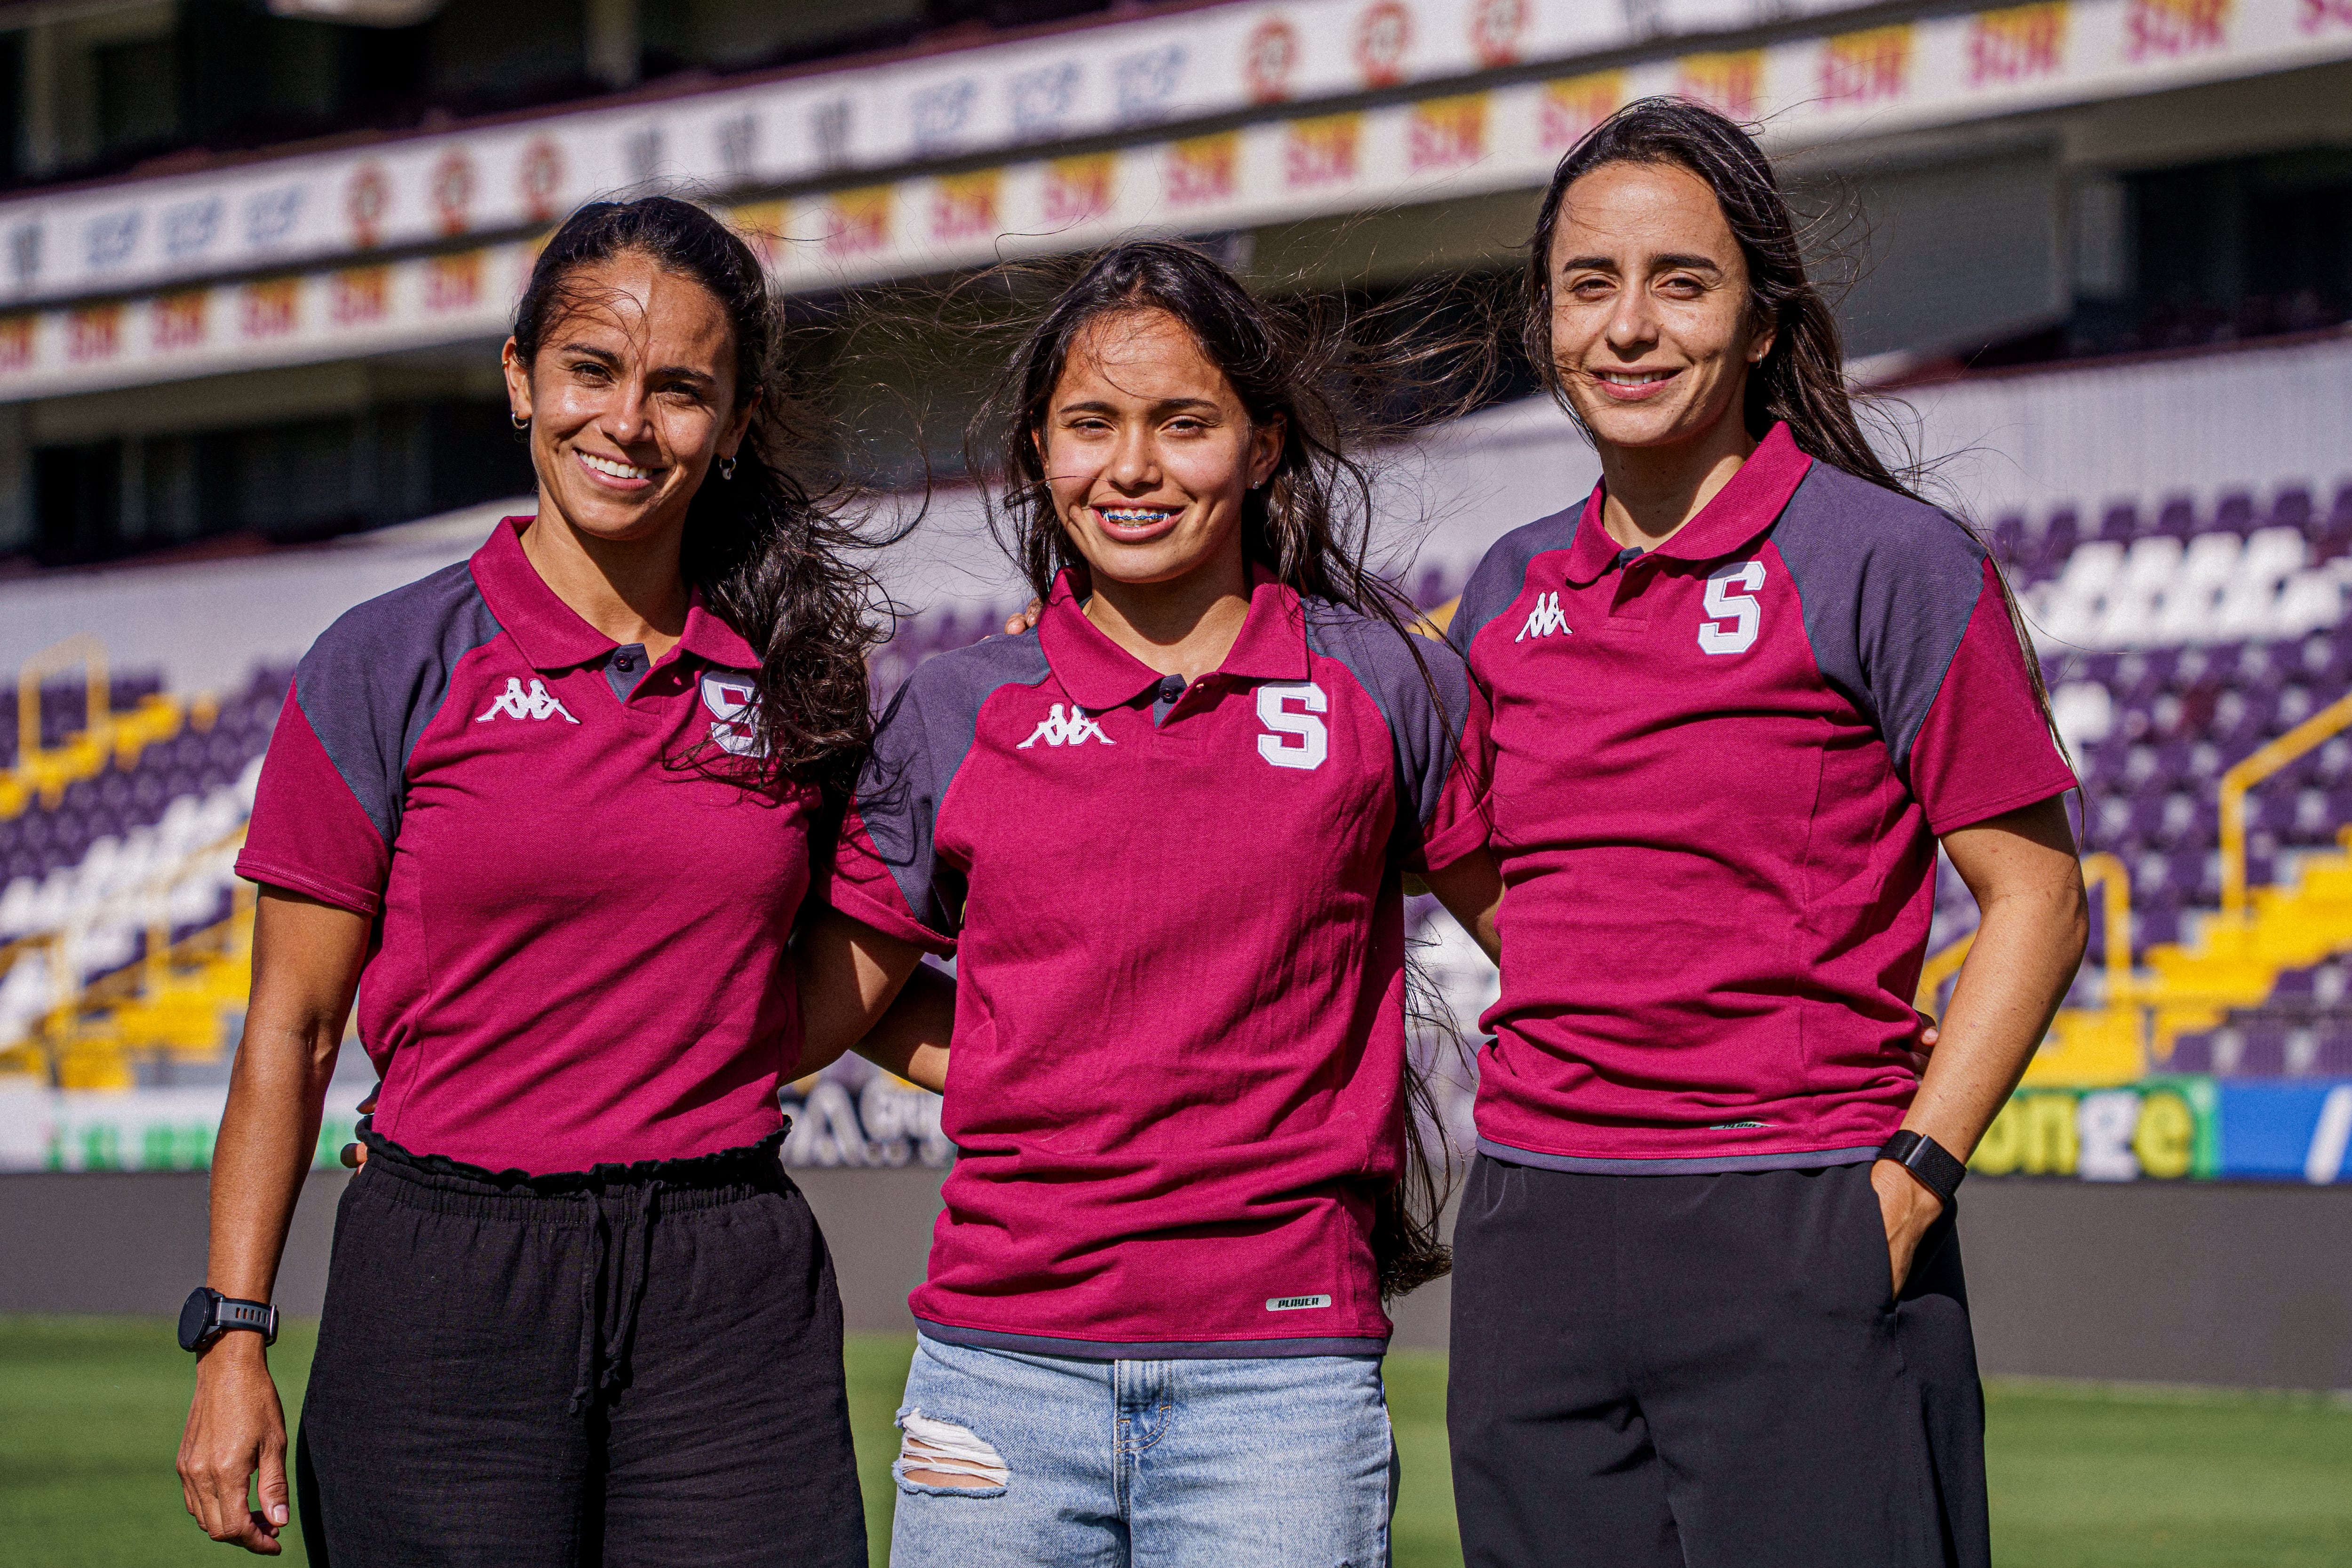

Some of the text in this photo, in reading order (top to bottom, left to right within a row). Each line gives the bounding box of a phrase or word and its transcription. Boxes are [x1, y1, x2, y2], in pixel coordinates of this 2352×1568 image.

[1697, 561, 1767, 655] S
[1257, 682, 1327, 770] S
[1278, 1297, 1319, 1308] PLAYER
